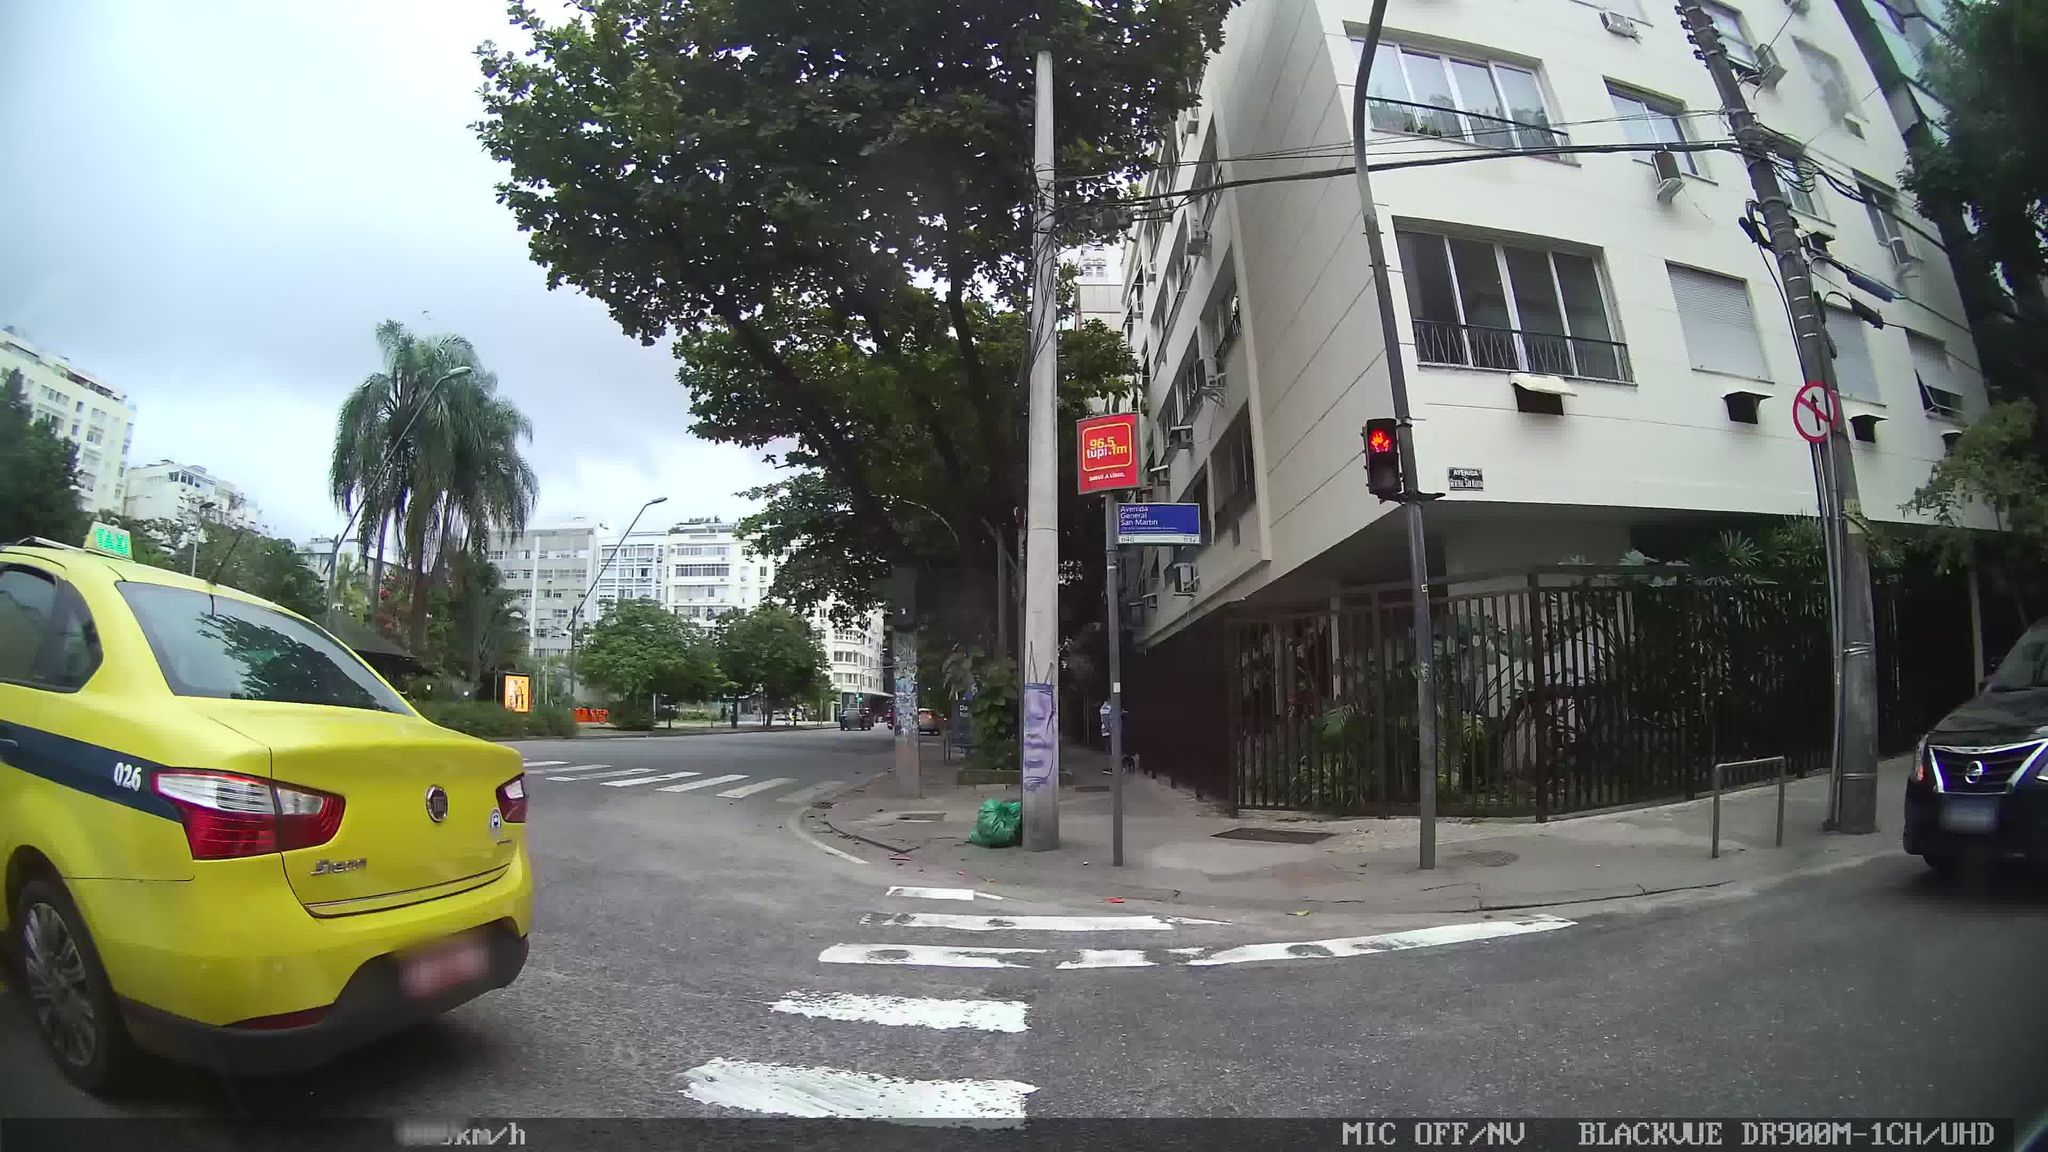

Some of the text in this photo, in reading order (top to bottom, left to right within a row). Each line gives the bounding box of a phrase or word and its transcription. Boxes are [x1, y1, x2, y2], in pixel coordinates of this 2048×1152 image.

[1090, 436, 1115, 450] 96.5
[96, 527, 129, 556] TAXI
[114, 762, 141, 791] 026
